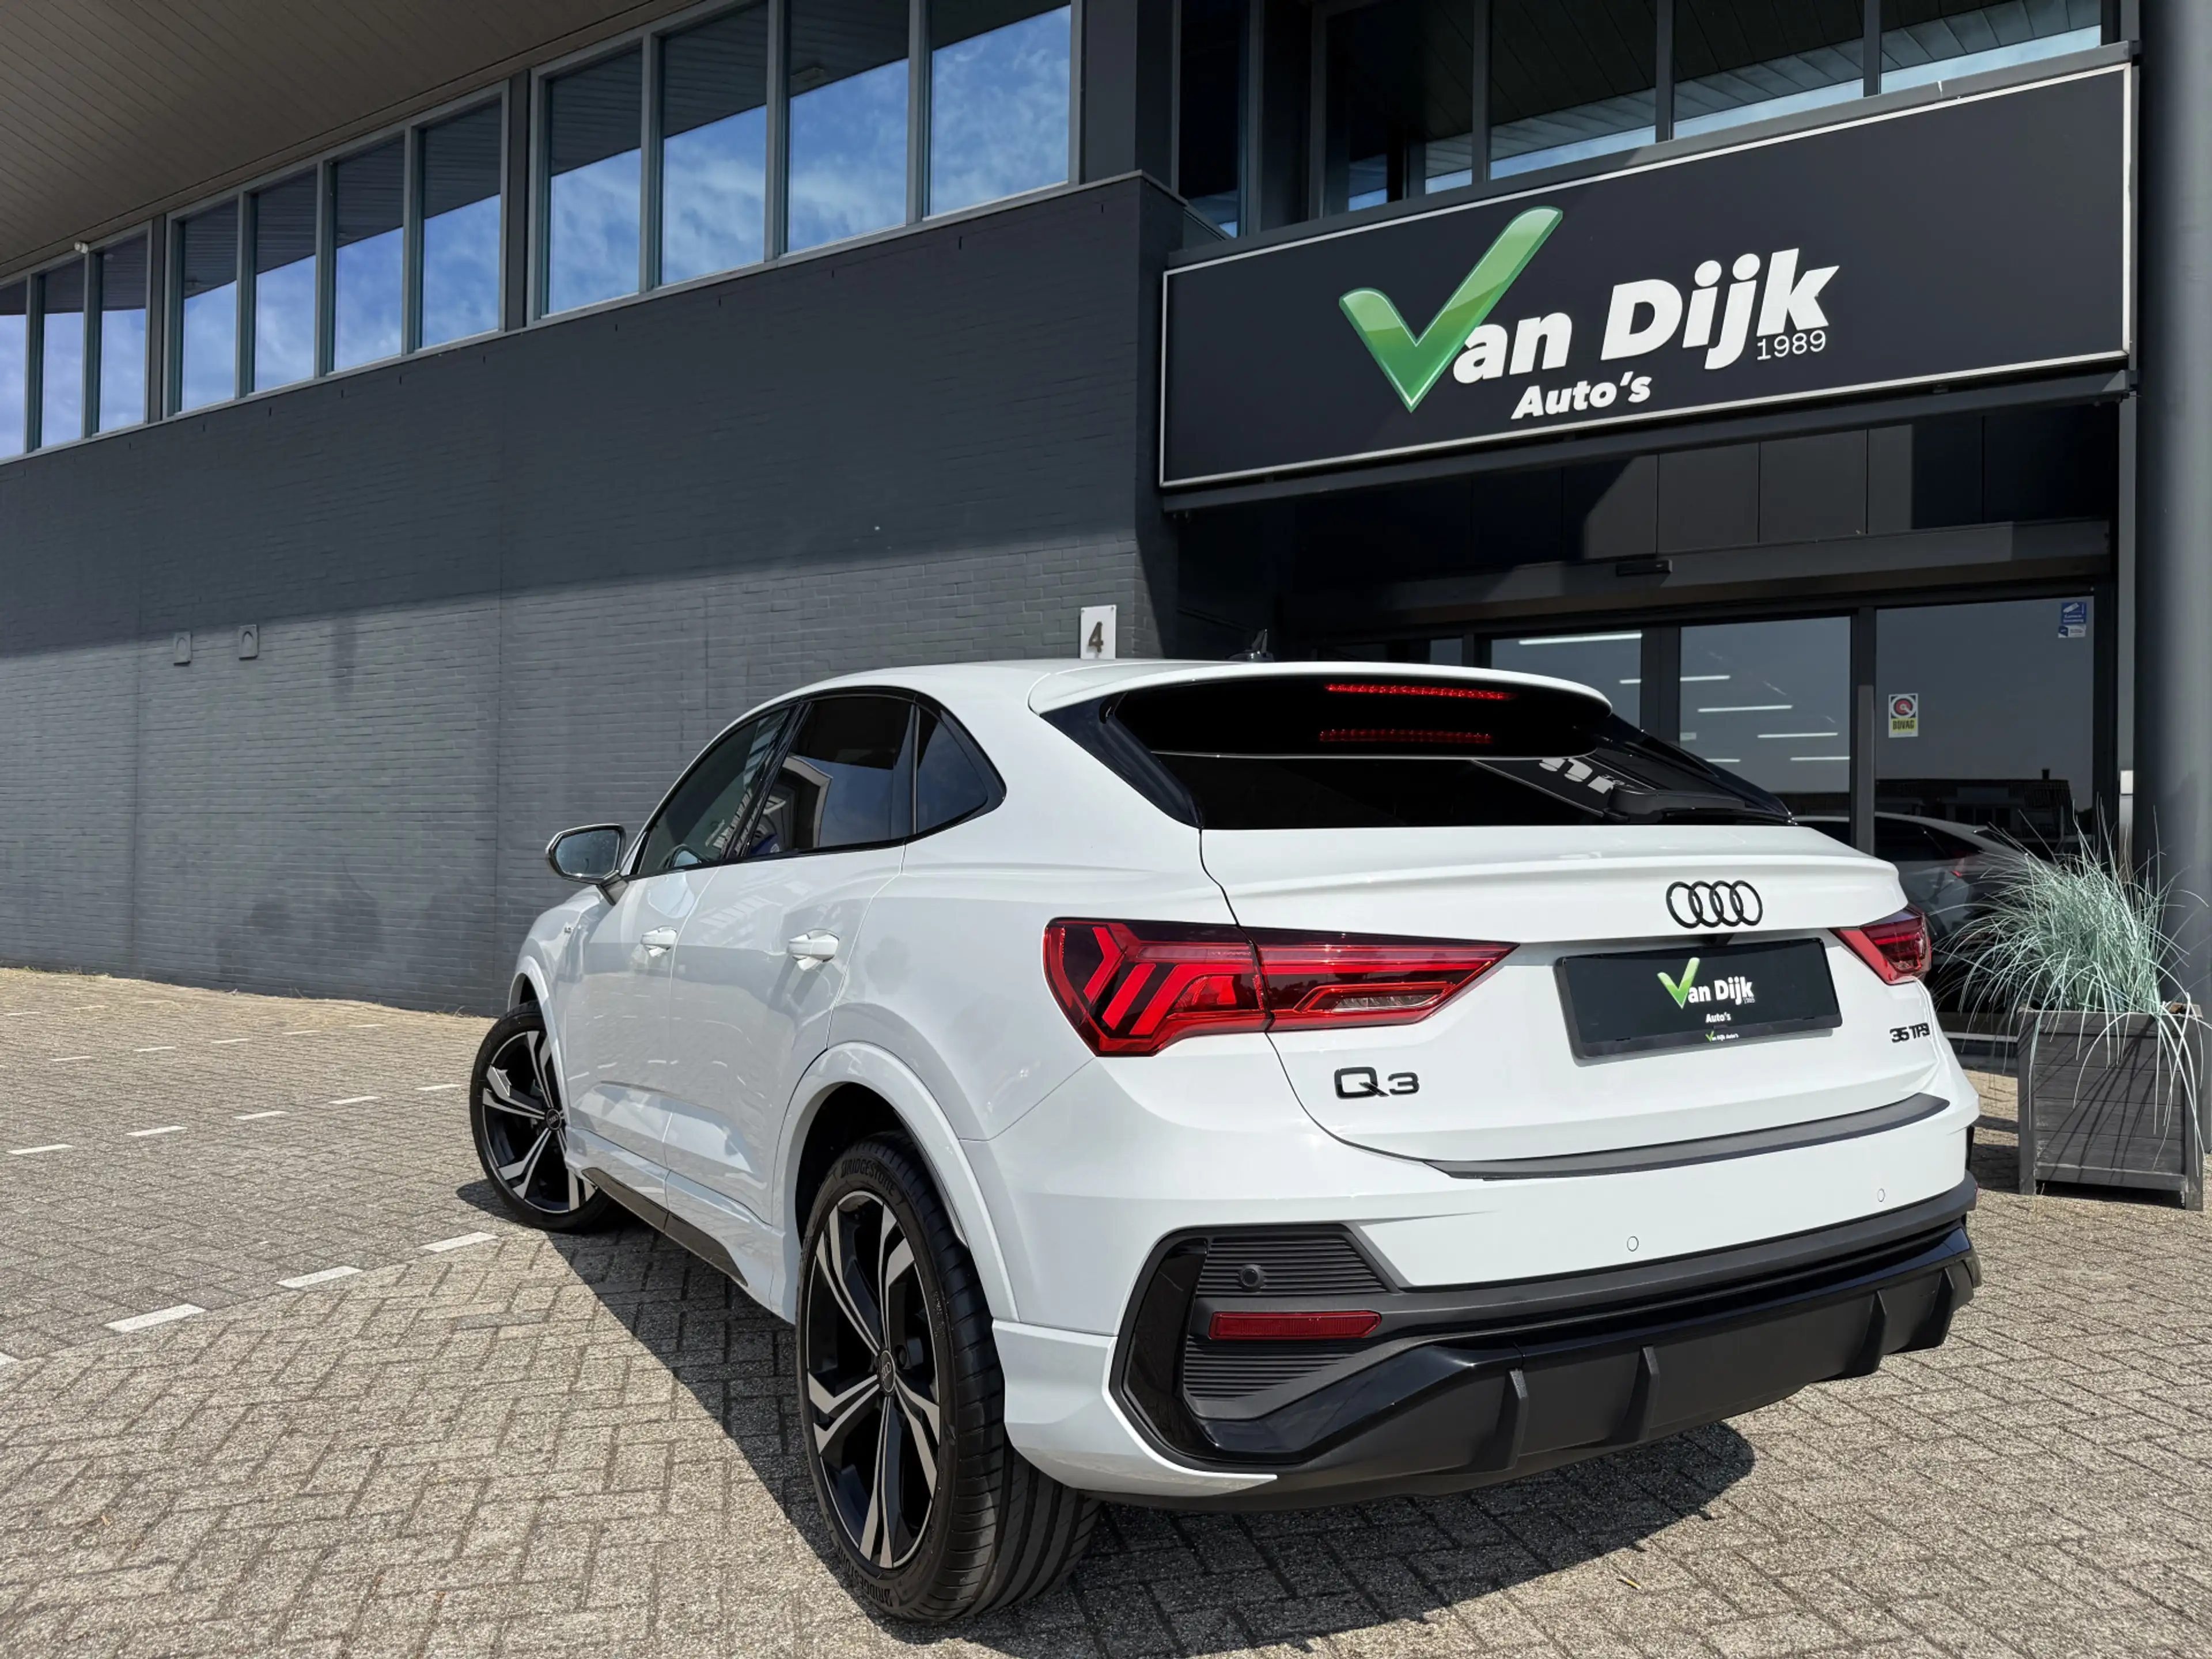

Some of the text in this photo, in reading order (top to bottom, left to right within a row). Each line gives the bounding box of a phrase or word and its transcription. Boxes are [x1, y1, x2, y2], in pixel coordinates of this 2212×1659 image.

[1339, 206, 1840, 413] Van Dijk
[1756, 329, 1826, 361] 1989
[1510, 370, 1652, 420] Auto's
[1089, 622, 1104, 653] 4
[1714, 976, 1754, 1005] Dijk
[1705, 1012, 1732, 1023] Auto's
[1889, 1027, 1910, 1043] 35
